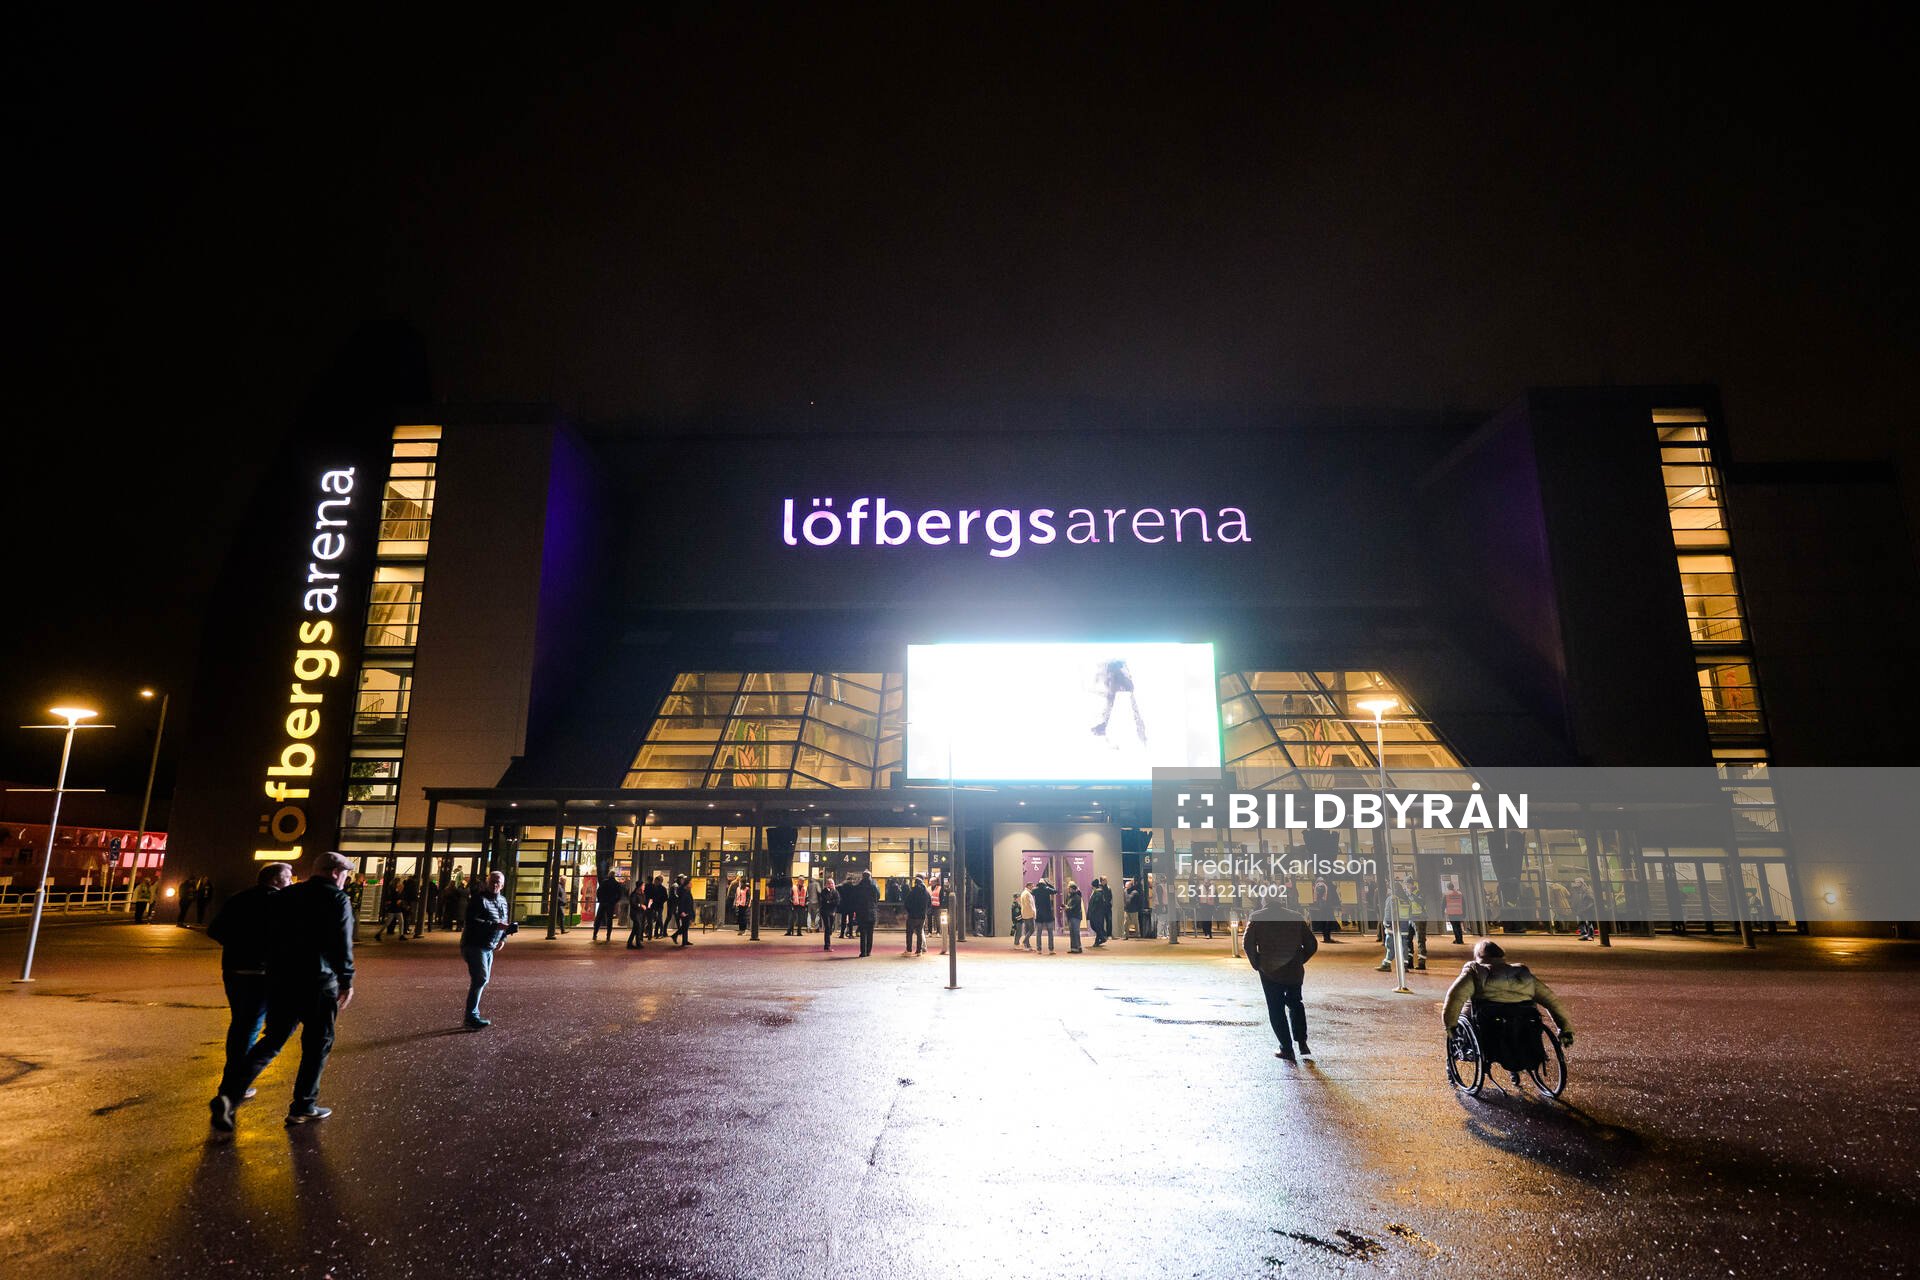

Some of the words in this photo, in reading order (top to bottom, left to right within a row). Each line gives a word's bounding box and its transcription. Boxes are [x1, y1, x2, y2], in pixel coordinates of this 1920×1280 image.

[725, 854, 731, 862] 2
[814, 854, 819, 862] 3
[843, 854, 849, 862] 4
[933, 854, 939, 862] 5
[1144, 855, 1151, 864] 6
[1442, 857, 1453, 866] 10
